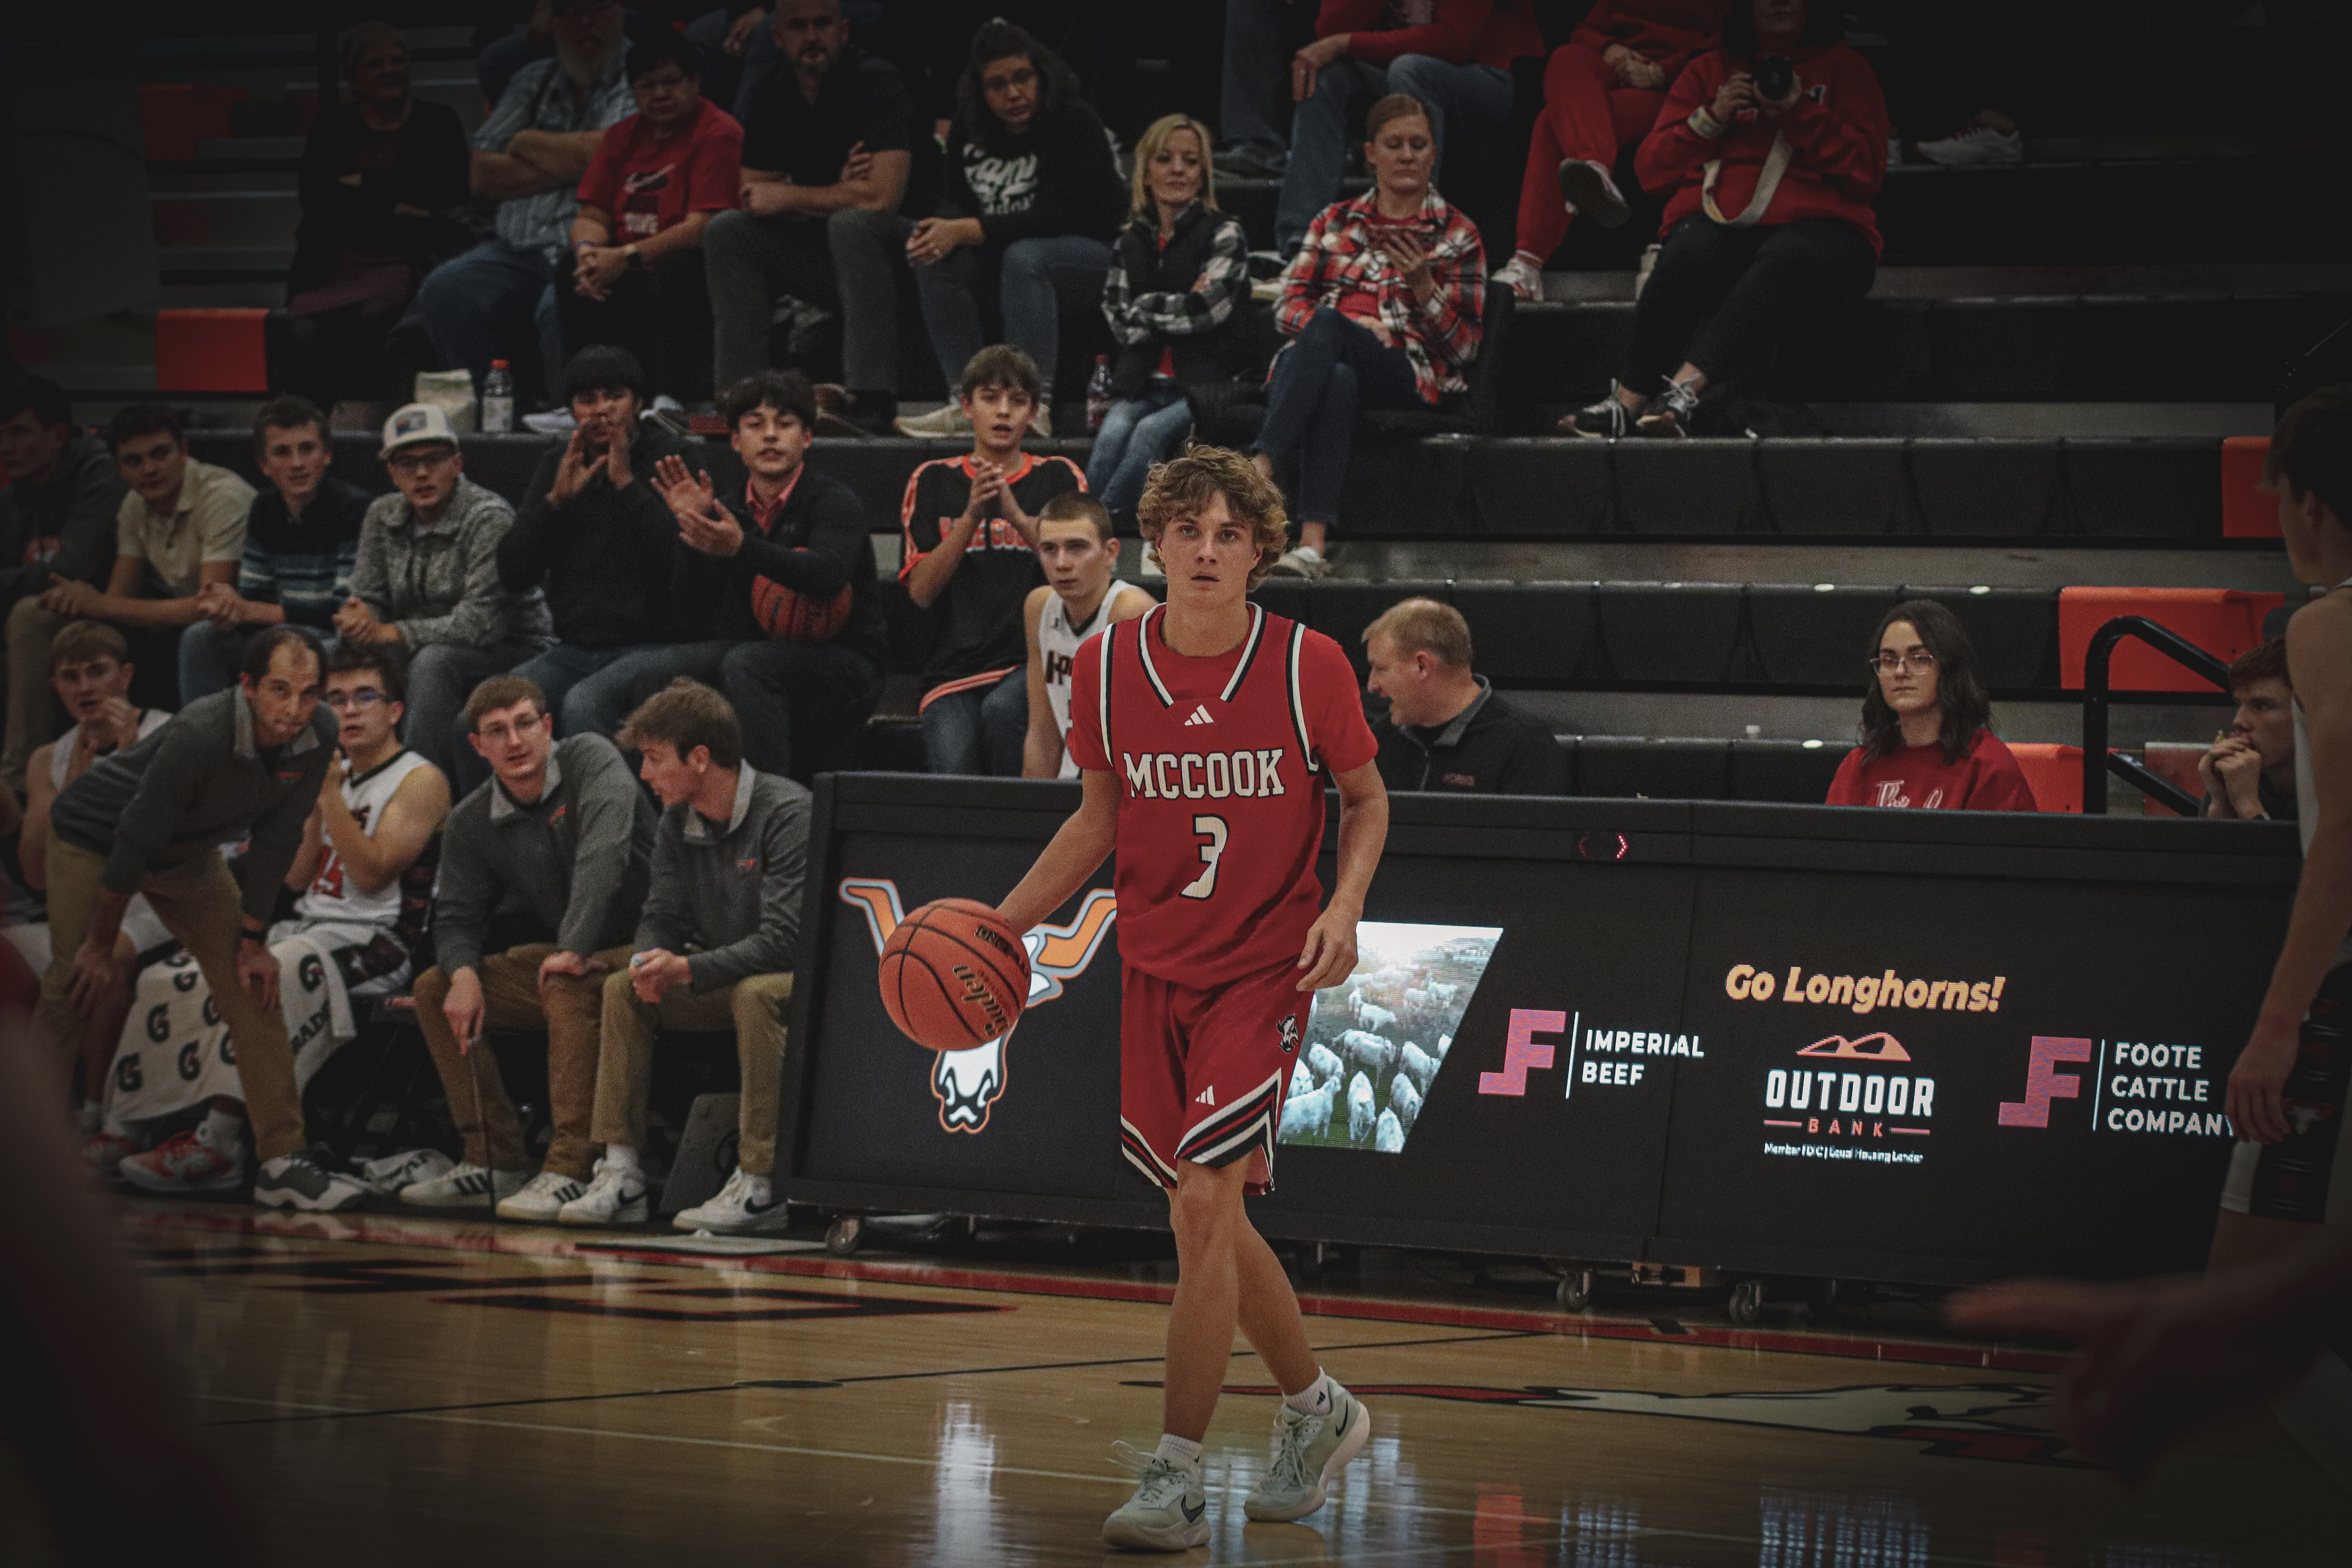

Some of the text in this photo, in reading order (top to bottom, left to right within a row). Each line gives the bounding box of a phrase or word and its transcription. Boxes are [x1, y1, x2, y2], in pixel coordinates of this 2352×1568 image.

[1123, 748, 1285, 799] MCCOOK
[1178, 814, 1230, 900] 3
[1726, 965, 2006, 1013] Go Longhorns!
[1585, 1029, 1705, 1058] IMPERIAL
[2114, 1042, 2202, 1069] FOOTE
[1581, 1060, 1645, 1086] BEEF
[2111, 1073, 2210, 1102] CATTLE
[1765, 1069, 1935, 1117] OUTDOOR
[1808, 1117, 1883, 1137] BANK
